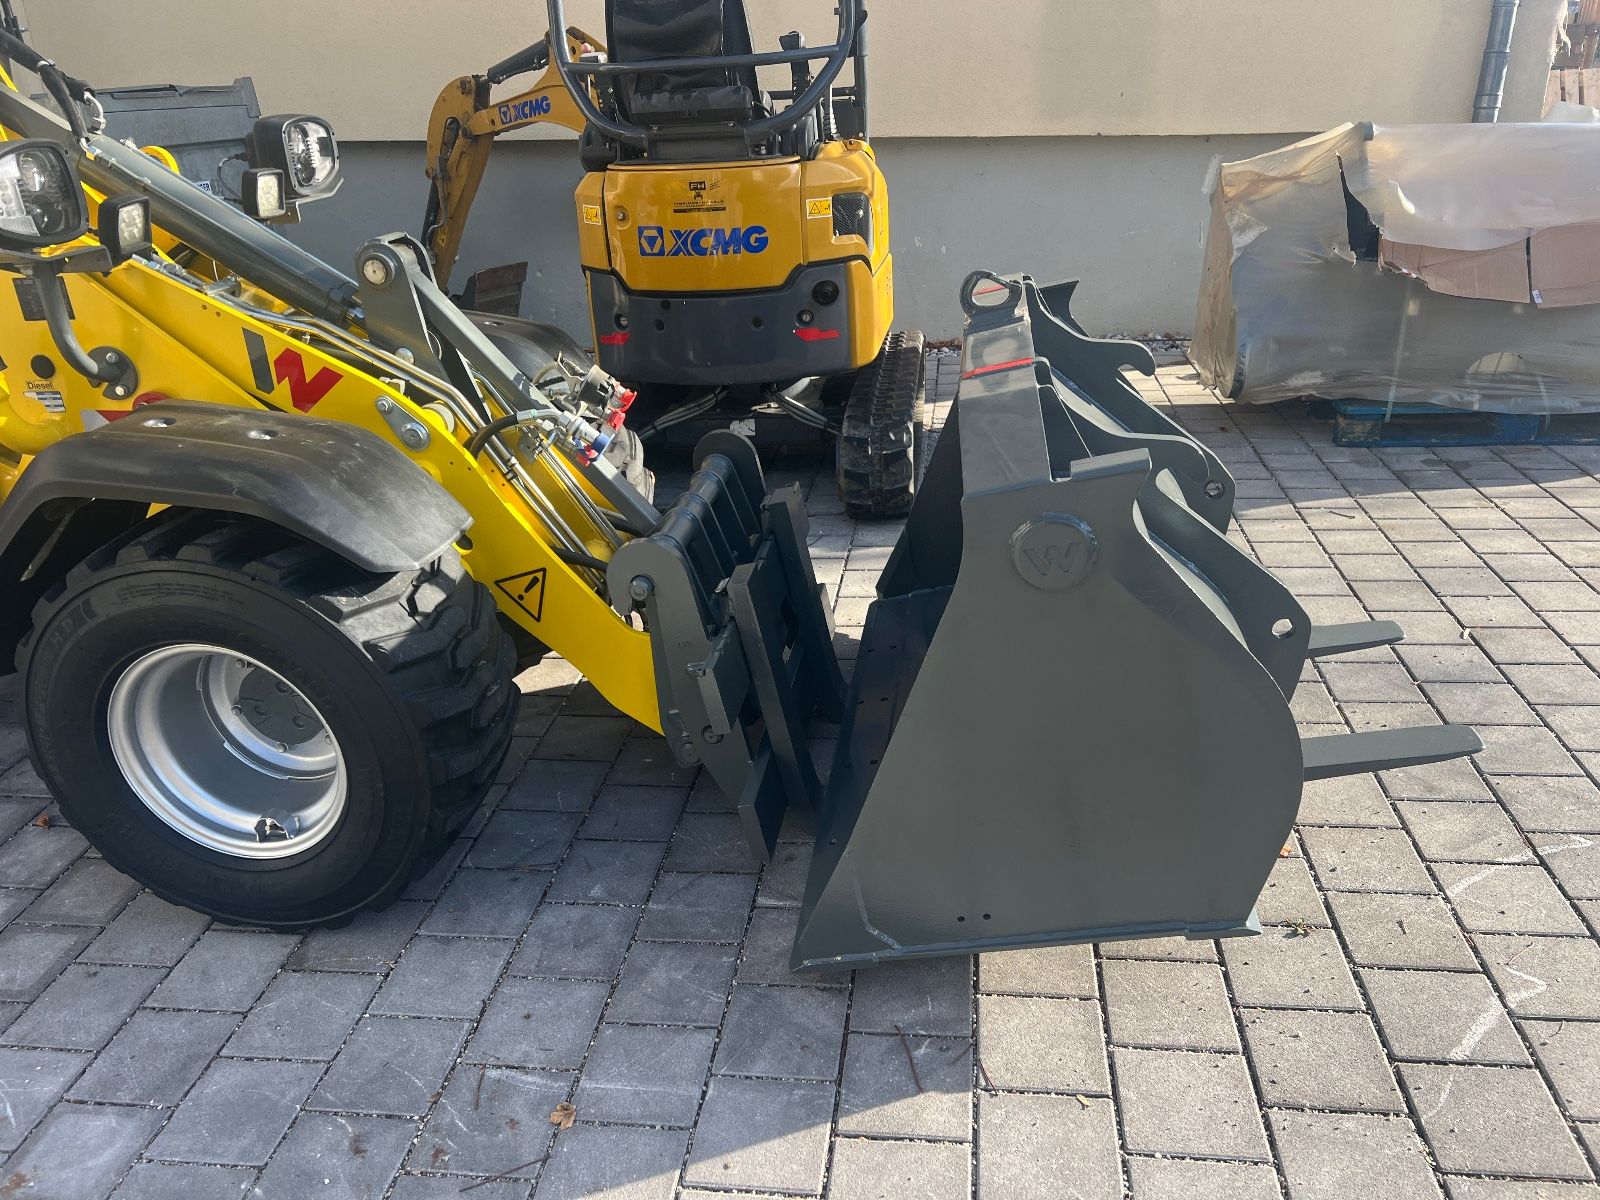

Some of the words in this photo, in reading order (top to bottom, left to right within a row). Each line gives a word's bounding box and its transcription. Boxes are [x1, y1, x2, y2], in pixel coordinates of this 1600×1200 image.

[512, 95, 551, 122] XCMG
[690, 181, 705, 190] FH
[666, 225, 769, 257] XCMG
[27, 381, 53, 390] Diesel
